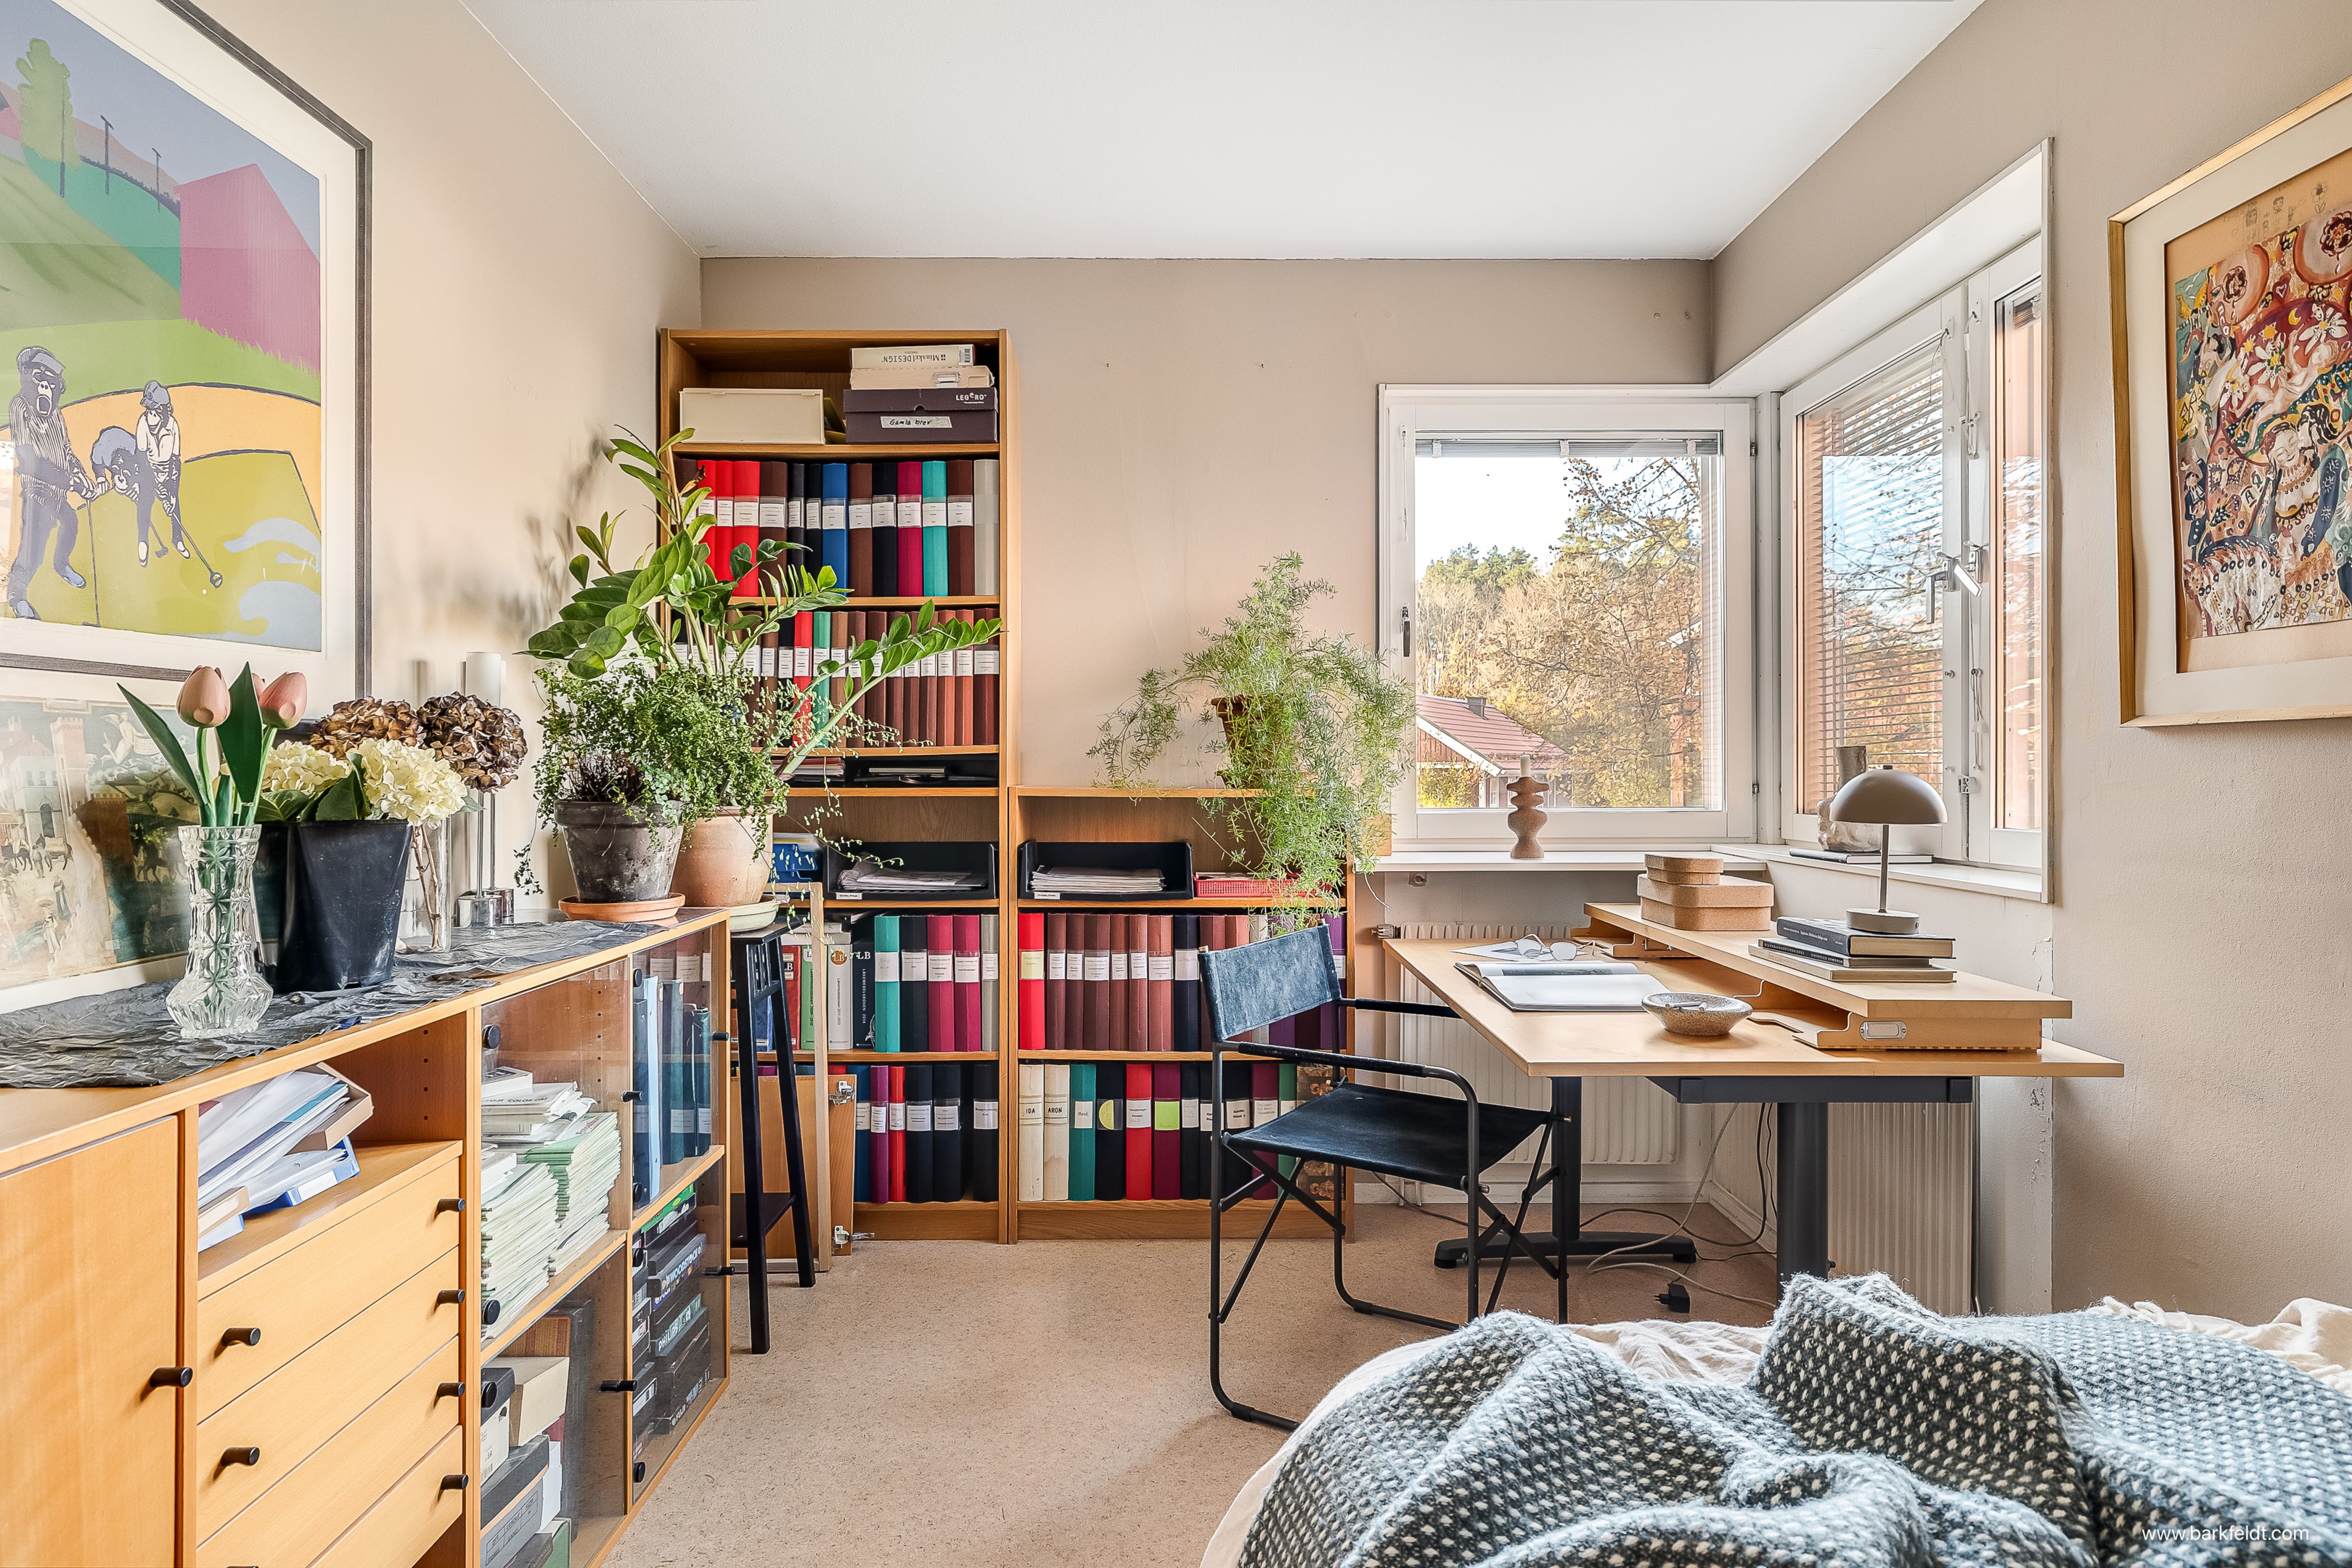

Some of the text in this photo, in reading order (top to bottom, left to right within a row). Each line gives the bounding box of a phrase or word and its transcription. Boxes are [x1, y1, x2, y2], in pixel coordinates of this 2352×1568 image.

[833, 953, 845, 962] LB
[658, 1323, 679, 1352] PHILIPS
[676, 1403, 686, 1422] FUJI
